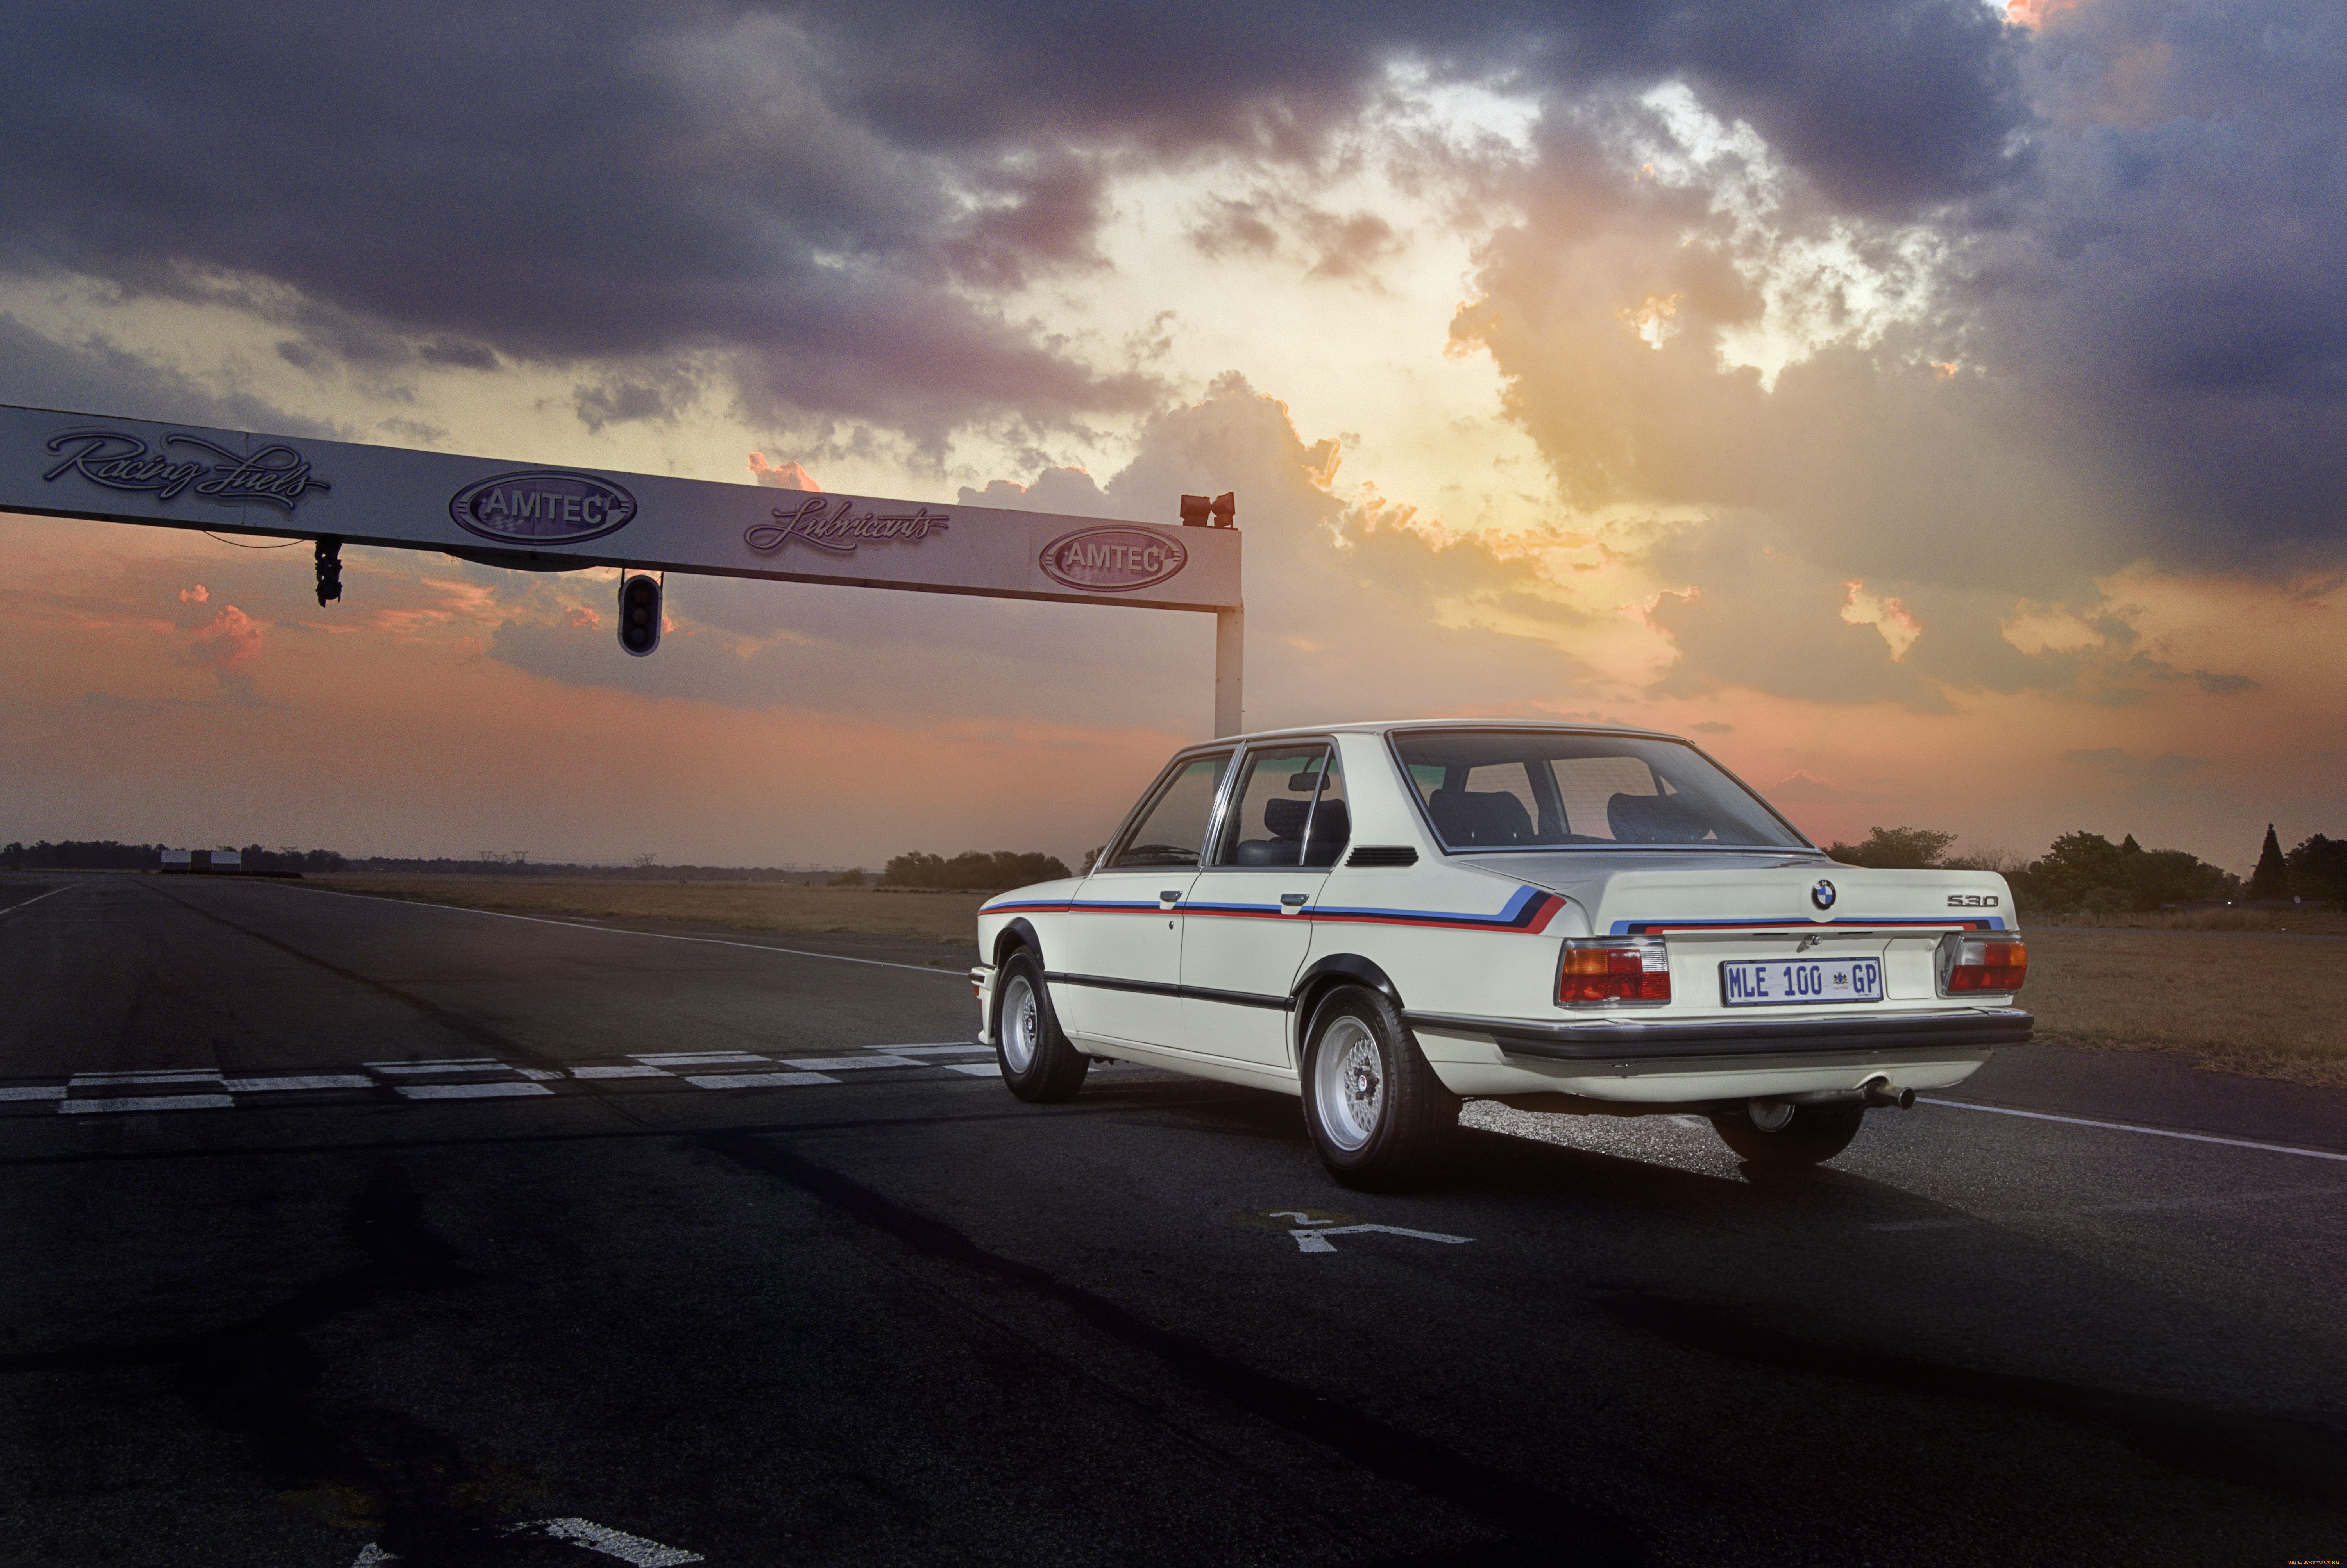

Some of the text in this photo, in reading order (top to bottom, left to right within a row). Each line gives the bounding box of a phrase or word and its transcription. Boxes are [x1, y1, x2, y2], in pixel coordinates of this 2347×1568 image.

[44, 433, 329, 509] Racing Fuels
[485, 488, 602, 524] AMTEC
[745, 498, 949, 549] Lubricants
[1066, 542, 1159, 572] AMTEC
[1947, 894, 1999, 907] 530
[1729, 964, 1877, 998] MLE 100 GP
